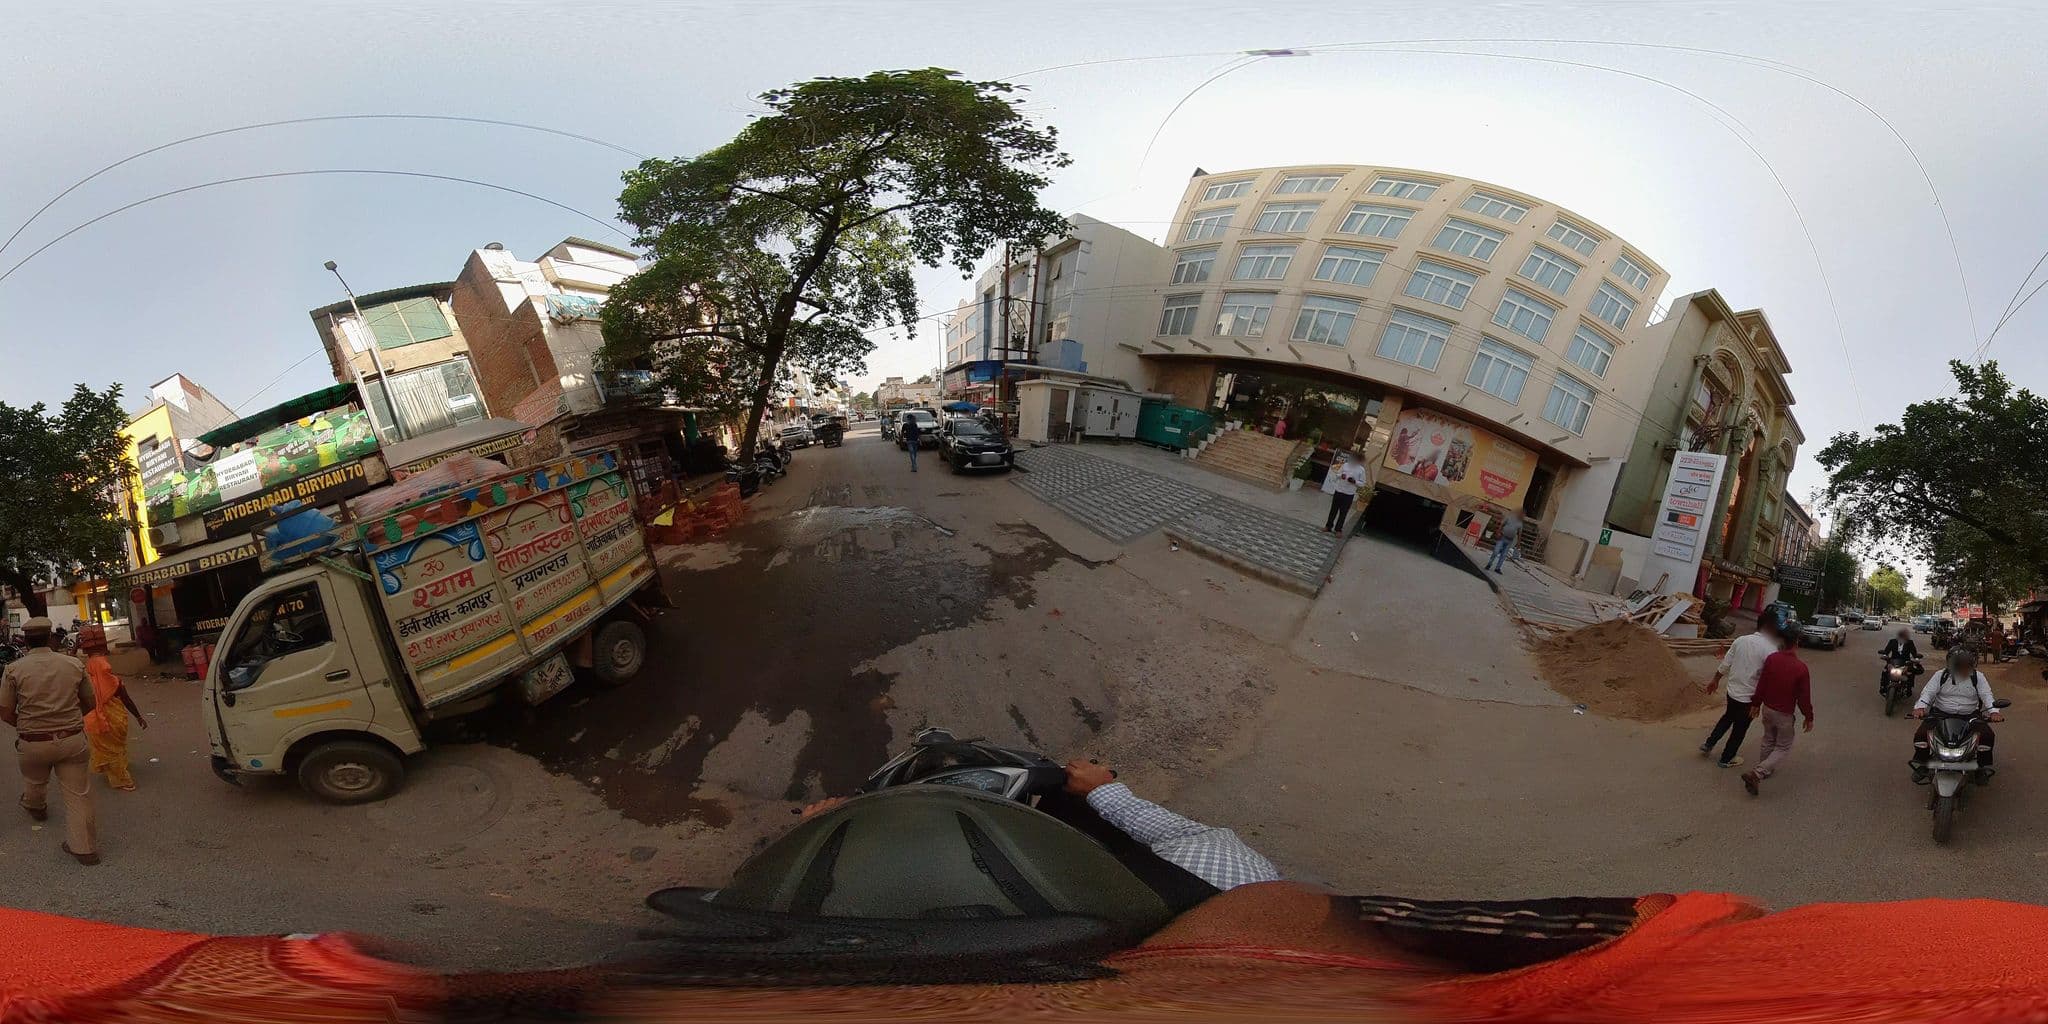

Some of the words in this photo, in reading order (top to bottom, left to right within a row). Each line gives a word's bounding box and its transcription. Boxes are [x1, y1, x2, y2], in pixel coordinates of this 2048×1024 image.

[139, 440, 171, 463] HYDEADI
[471, 434, 521, 457] RESTAURANT
[216, 460, 255, 478] HYDERABADI
[224, 469, 249, 480] BIRYANI
[219, 473, 259, 490] RESTAURANT
[223, 486, 294, 522] HYDERABADI
[296, 468, 346, 497] BIRYANI
[346, 463, 364, 481] 70
[511, 553, 569, 591] प्रयागराज
[412, 567, 475, 608] श्याम
